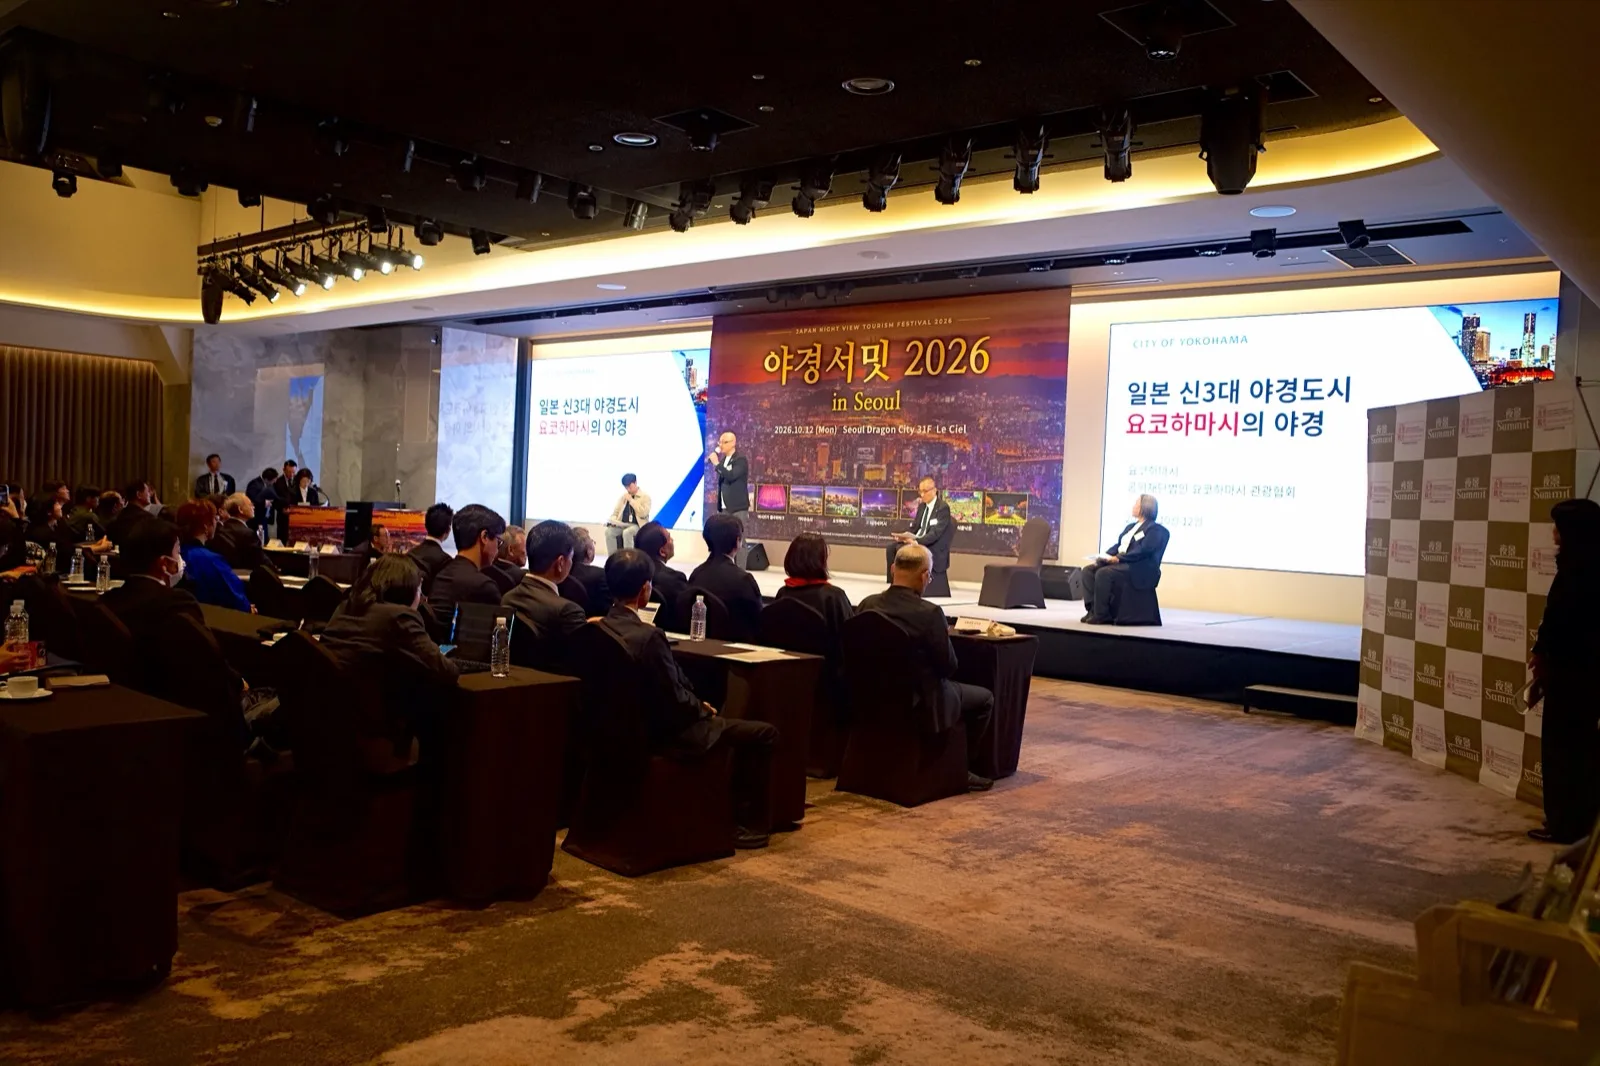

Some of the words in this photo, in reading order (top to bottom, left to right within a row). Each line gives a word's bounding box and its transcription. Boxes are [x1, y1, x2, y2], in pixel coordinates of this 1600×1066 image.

[795, 327, 817, 335] JAPAN
[863, 322, 894, 330] TOURISM
[897, 319, 932, 328] FESTIVAL
[1133, 339, 1157, 349] CITY
[1161, 338, 1175, 347] OF
[1180, 335, 1248, 346] YOKOHAMA
[764, 339, 890, 386] 야경서밋
[904, 335, 991, 376] 2026
[1128, 382, 1171, 405] 일본
[1179, 379, 1240, 404] 신3대
[1250, 376, 1351, 404] 야경도시
[539, 399, 559, 415] 일본
[563, 397, 590, 415] 신3대
[594, 396, 639, 414] 야경도시
[831, 392, 848, 411] in
[853, 390, 901, 412] Seoul
[539, 419, 601, 436] 요코하마시의
[605, 419, 627, 436] 야경
[774, 425, 814, 434] 2026.10.12
[815, 425, 838, 435] (Mon)
[842, 425, 865, 434] Seoul
[867, 425, 896, 435] Dragon
[898, 425, 915, 436] City
[916, 425, 932, 434] 31F
[936, 425, 947, 434] Le
[948, 424, 967, 434] Ciel
[1126, 411, 1264, 437] 요코하마시의
[1275, 411, 1324, 437] 야경
[1496, 420, 1530, 431] Summit
[1428, 428, 1455, 439] Summit
[1393, 492, 1420, 501] Summit
[1456, 489, 1486, 500] Summit
[1533, 488, 1571, 500] Summit
[1421, 553, 1448, 563] Summit
[1489, 556, 1524, 569] Summit
[1387, 608, 1413, 620] Summit
[1449, 618, 1481, 632] Summit
